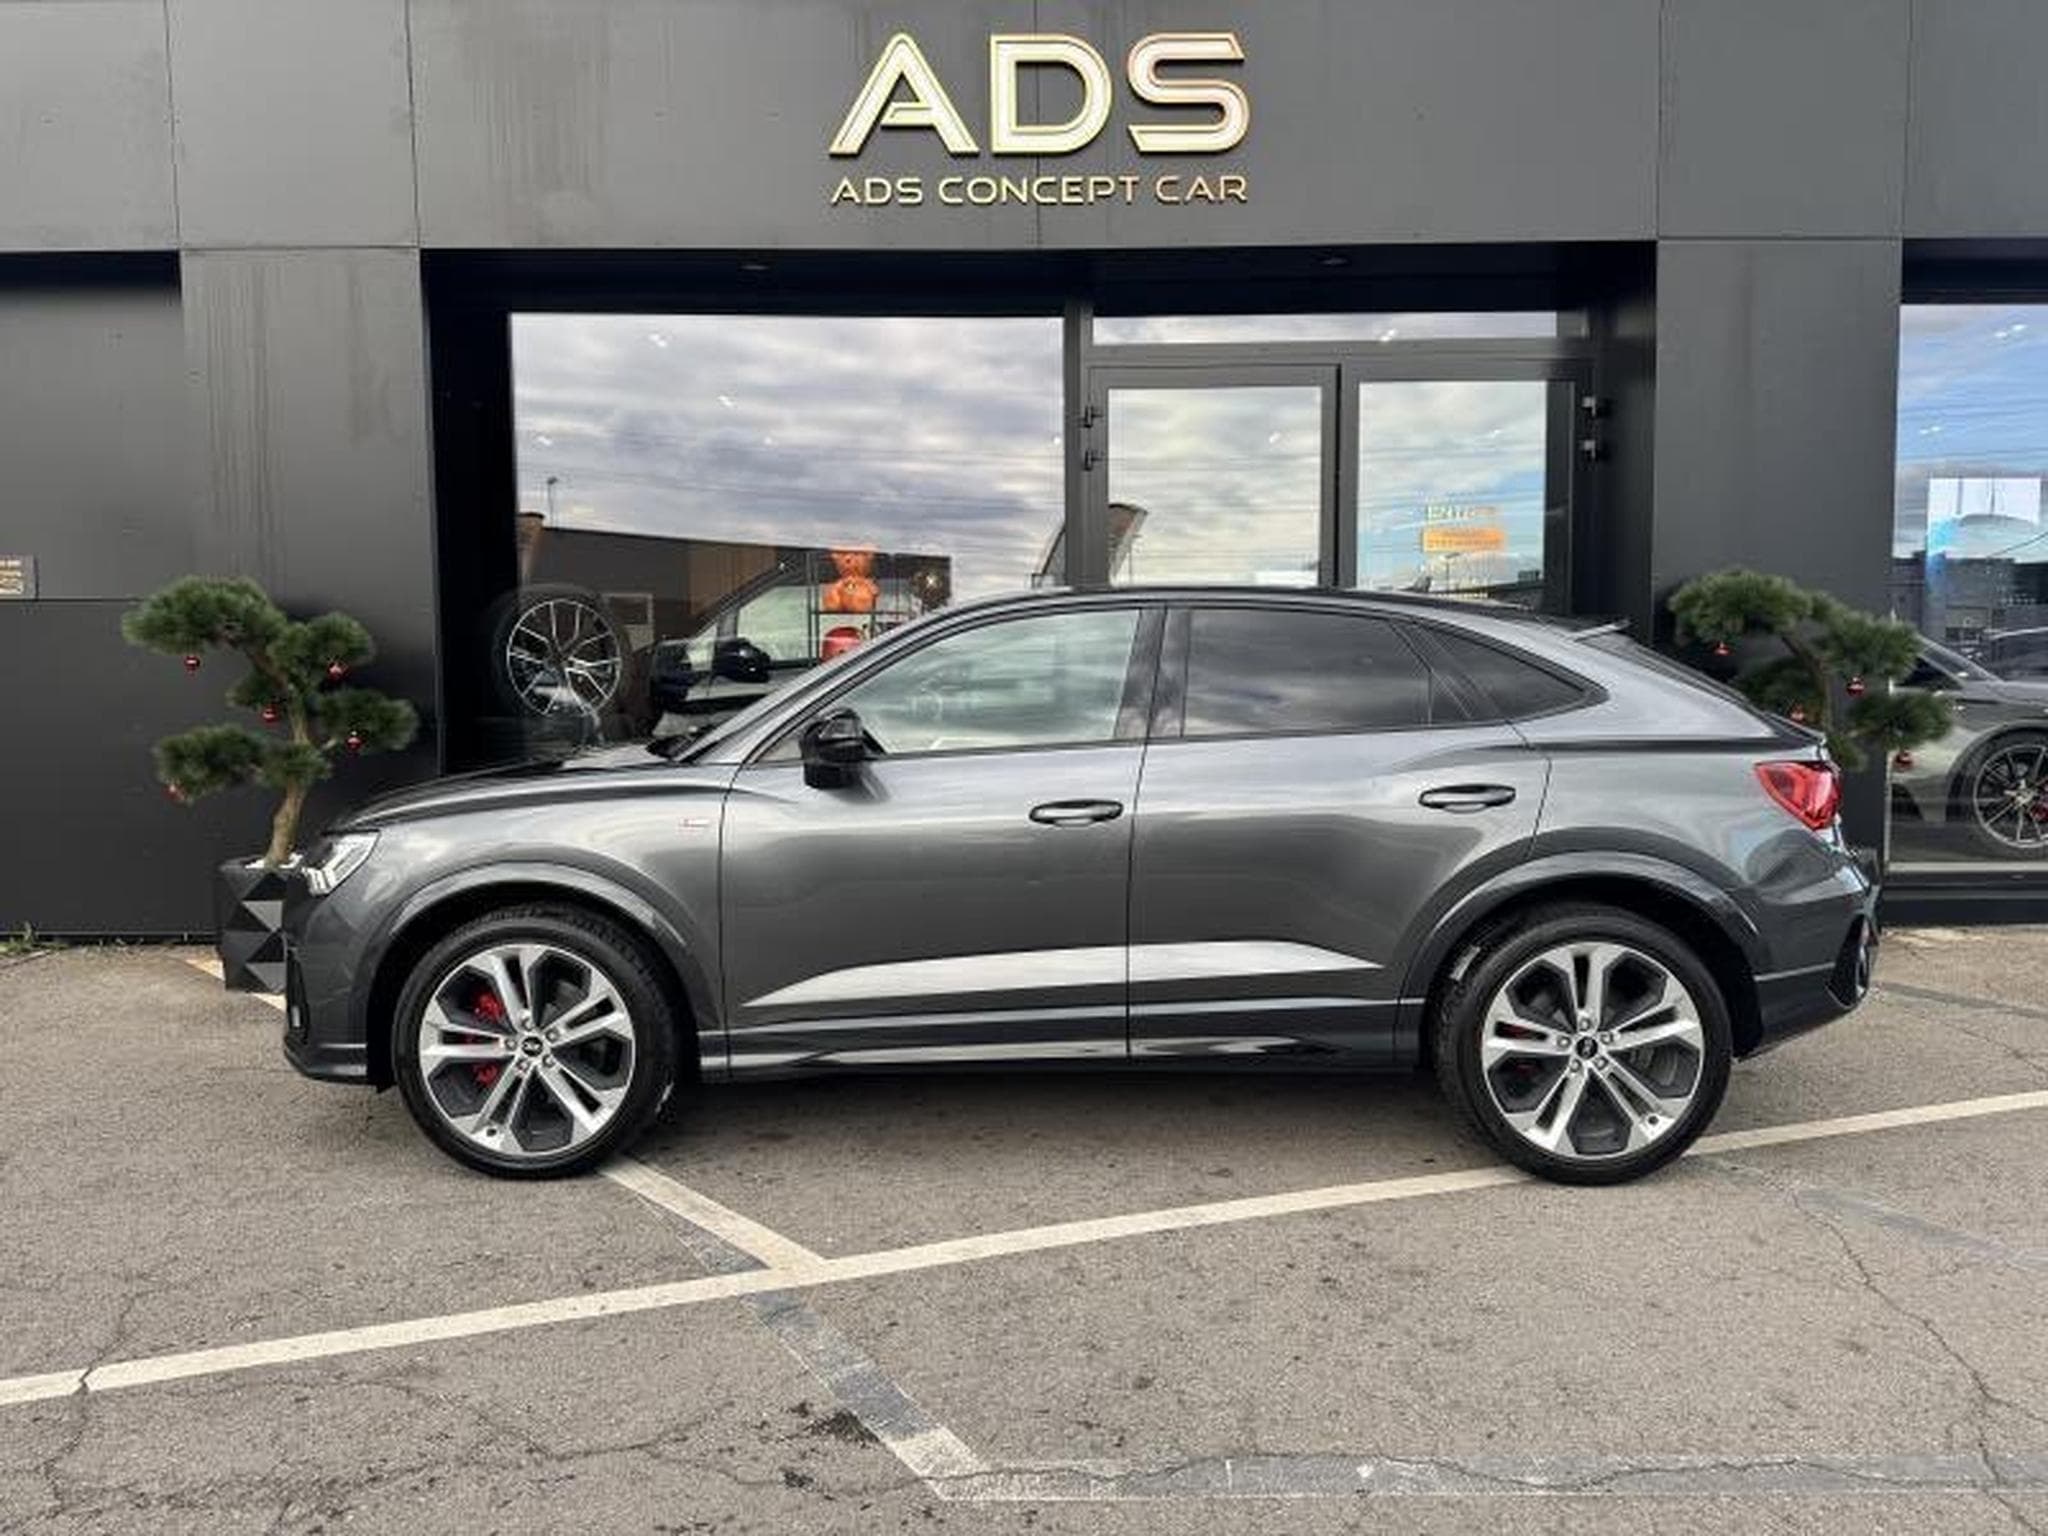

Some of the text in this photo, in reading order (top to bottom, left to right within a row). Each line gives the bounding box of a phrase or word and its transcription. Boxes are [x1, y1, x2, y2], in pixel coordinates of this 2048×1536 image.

[828, 32, 1250, 155] ADS
[830, 174, 1248, 204] ADS CONCEPT CAR
